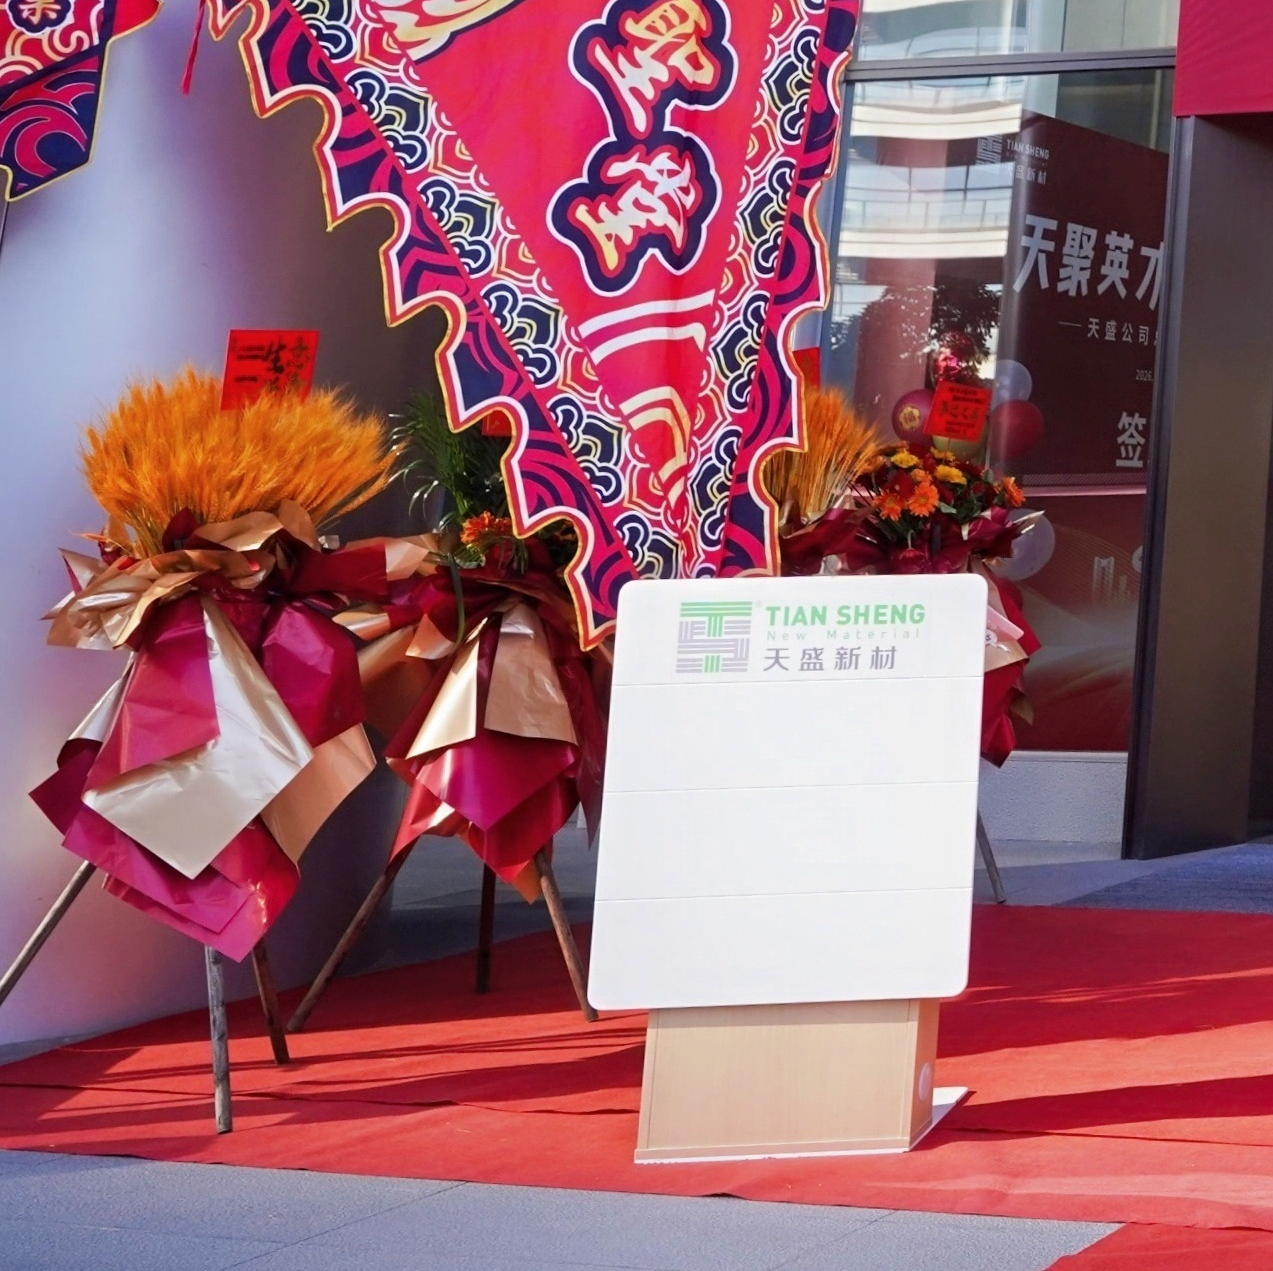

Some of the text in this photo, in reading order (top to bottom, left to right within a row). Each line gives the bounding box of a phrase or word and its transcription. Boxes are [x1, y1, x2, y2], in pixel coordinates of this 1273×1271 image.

[766, 604, 926, 627] TIAN SHENG
[766, 628, 920, 641] New Material
[763, 646, 897, 672] 天盛新材
